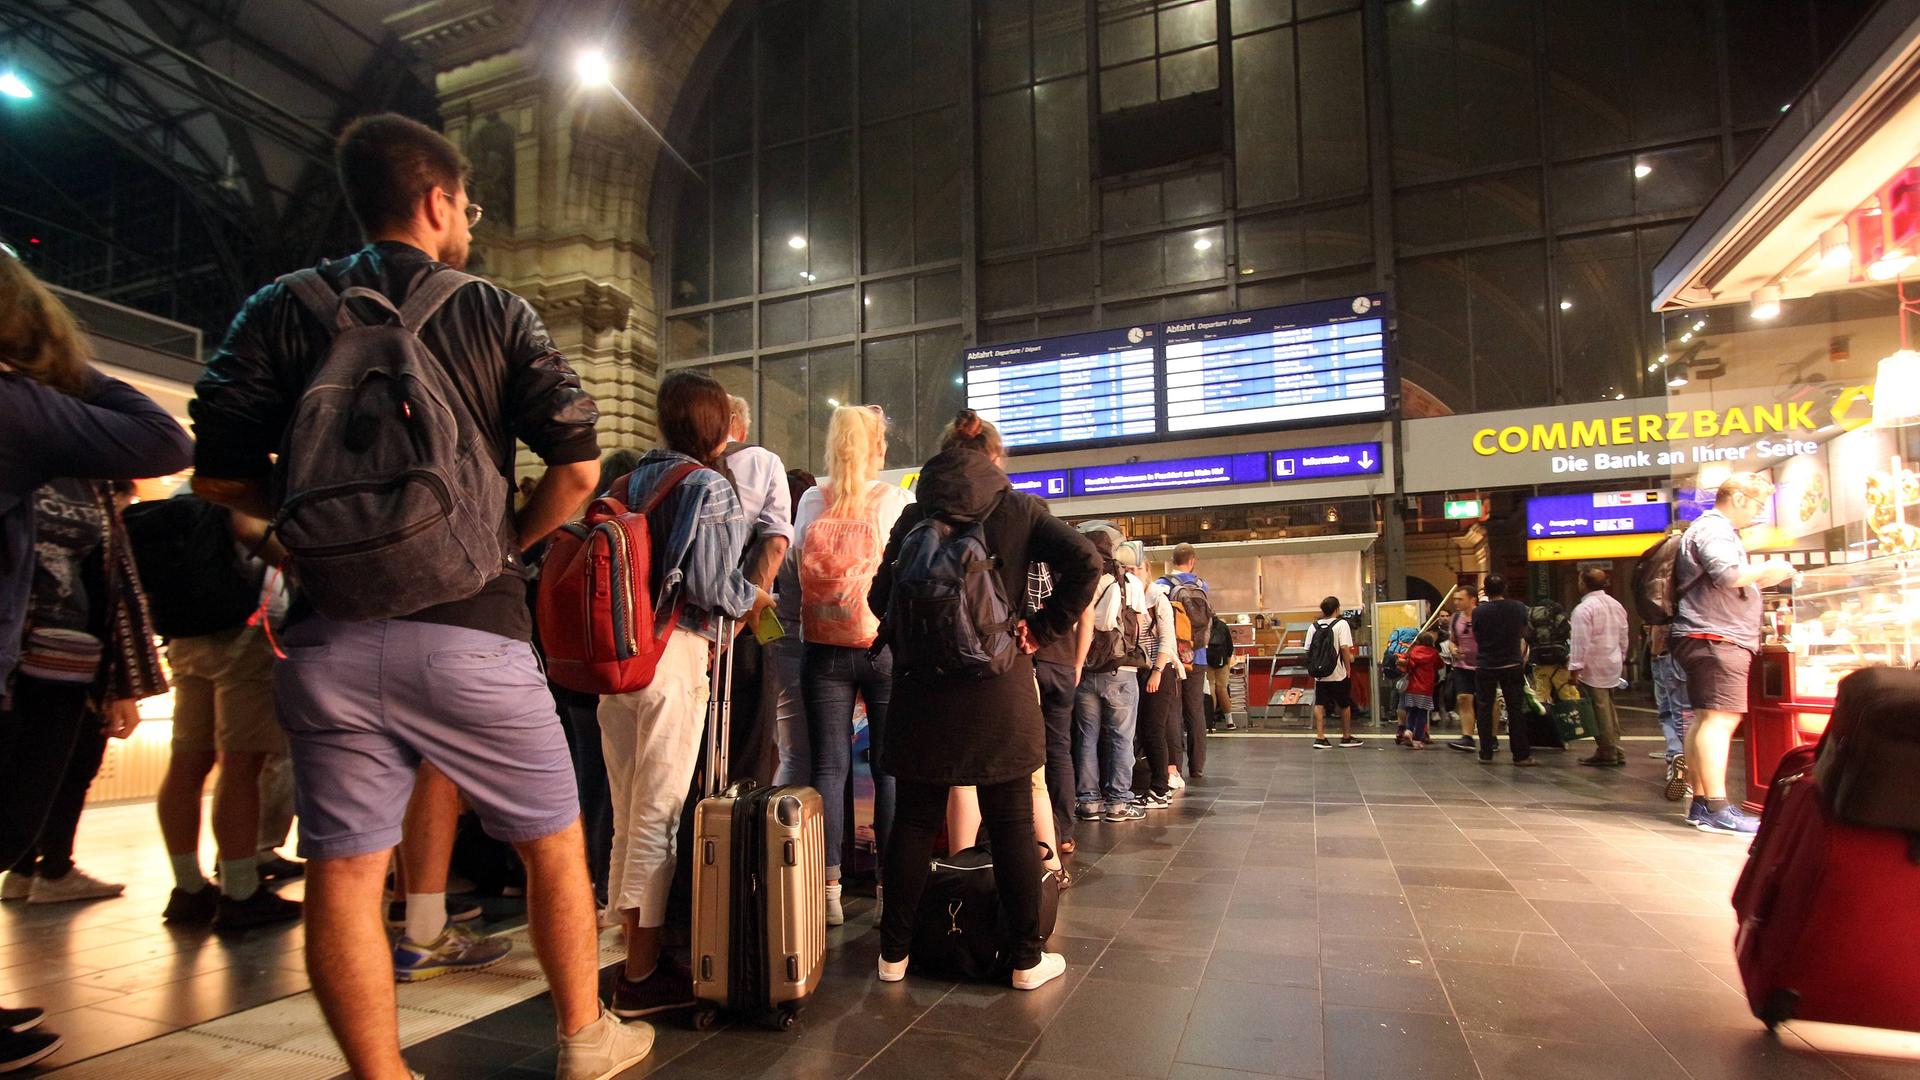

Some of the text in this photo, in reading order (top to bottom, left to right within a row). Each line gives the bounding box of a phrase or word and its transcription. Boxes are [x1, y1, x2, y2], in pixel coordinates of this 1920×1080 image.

[1166, 323, 1196, 334] Abfahrt
[1197, 321, 1227, 331] Departure
[967, 349, 994, 361] Abfahrt
[1472, 401, 1816, 456] COMMERZBANK
[1302, 455, 1350, 466] Information
[1551, 438, 1818, 474] Die Bank an Ihrer Seite
